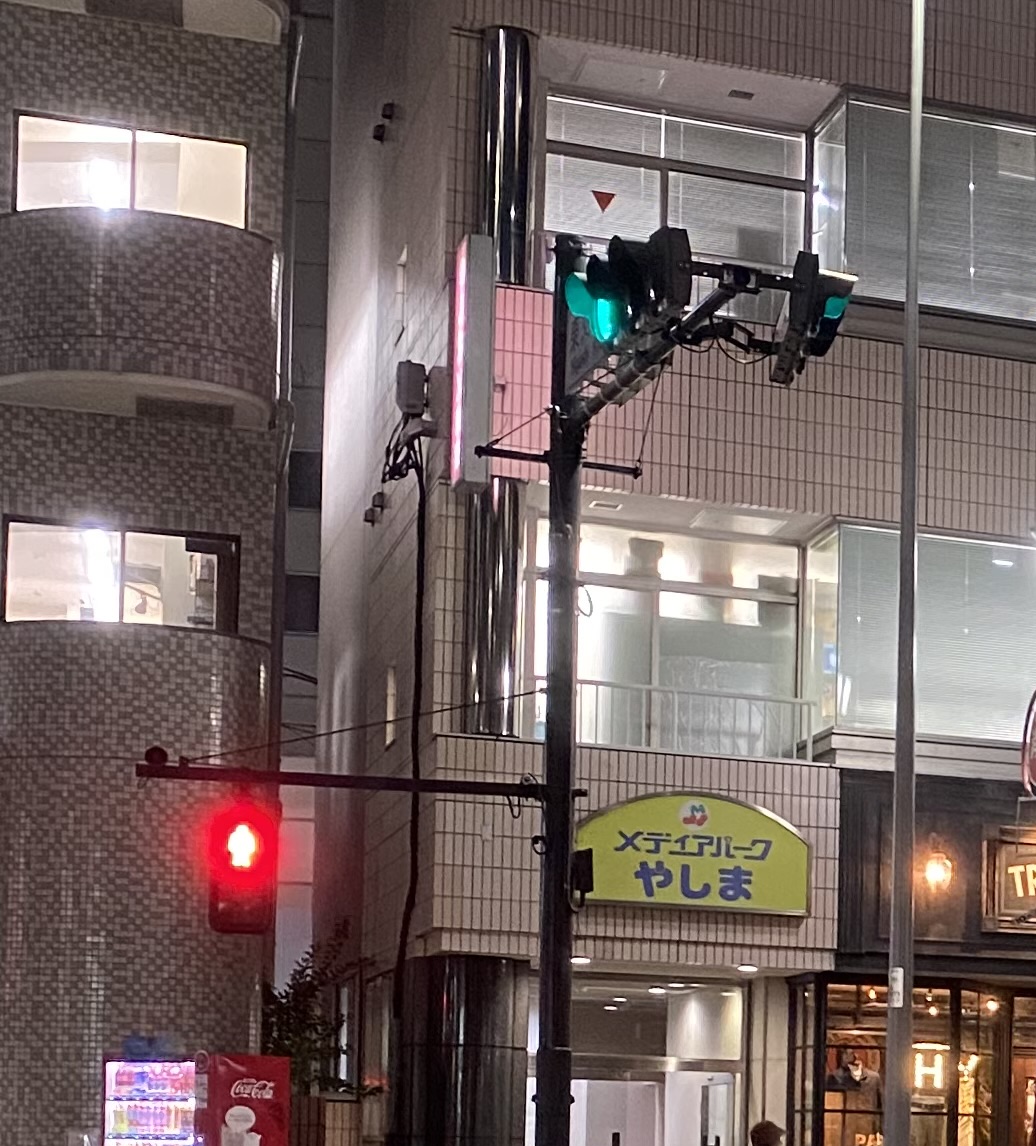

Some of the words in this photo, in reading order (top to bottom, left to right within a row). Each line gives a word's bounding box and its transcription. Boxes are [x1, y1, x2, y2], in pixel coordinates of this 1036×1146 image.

[613, 830, 773, 861] メディアパーク
[633, 860, 753, 902] やしま
